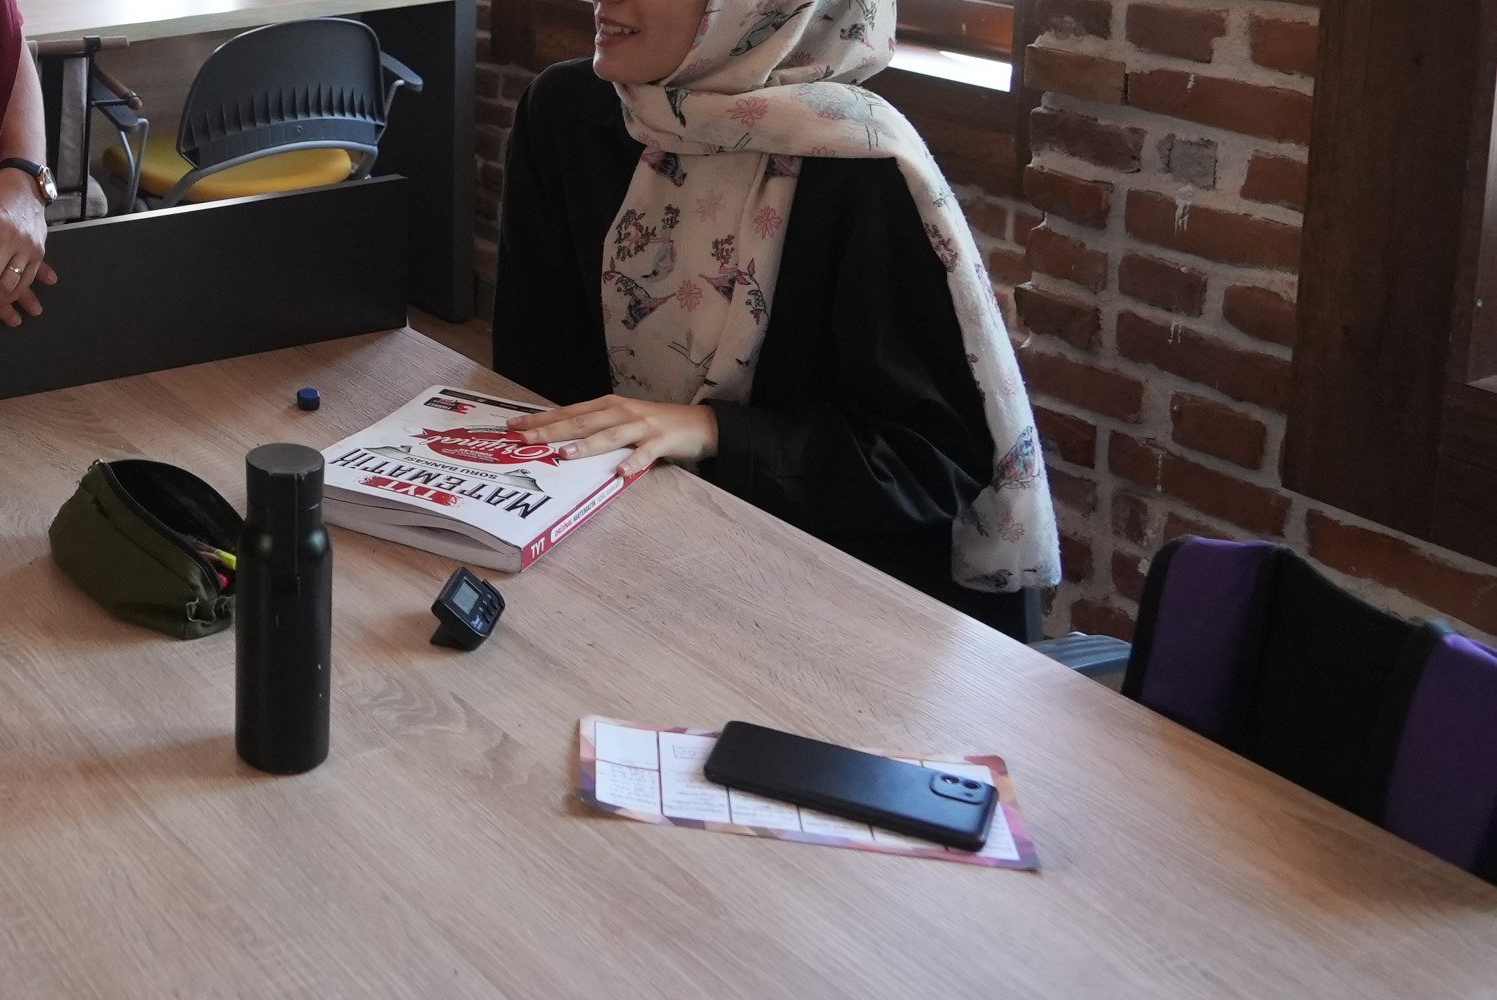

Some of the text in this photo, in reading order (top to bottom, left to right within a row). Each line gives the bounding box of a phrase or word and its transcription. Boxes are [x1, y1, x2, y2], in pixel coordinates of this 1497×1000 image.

[404, 456, 498, 480] SORU BANKASI
[328, 448, 553, 520] MATEMATİK
[377, 479, 434, 501] TYT
[531, 537, 545, 558] TYT
